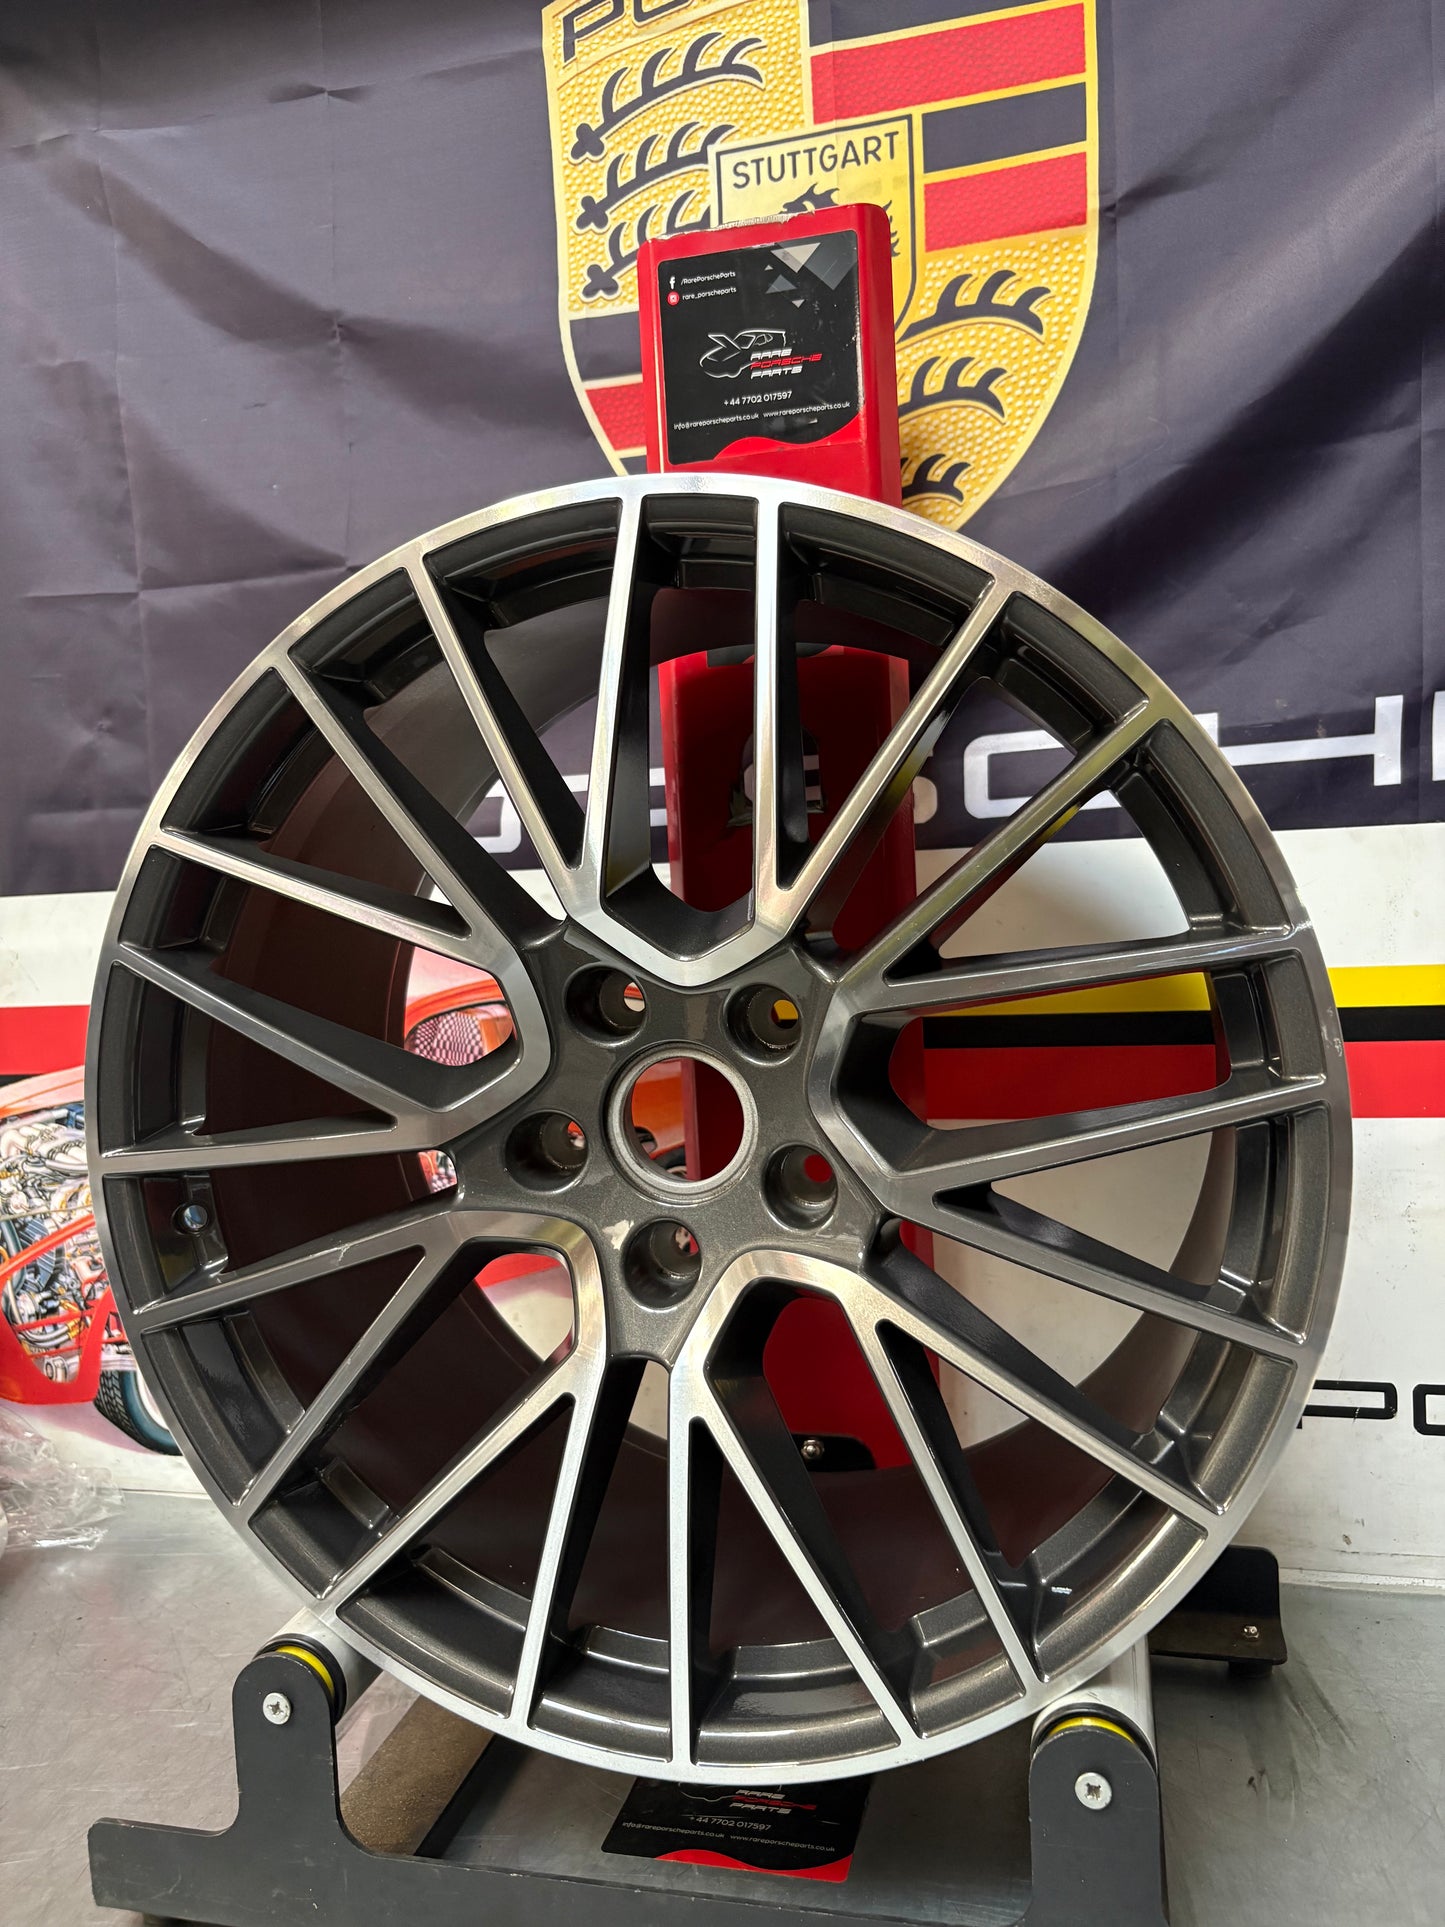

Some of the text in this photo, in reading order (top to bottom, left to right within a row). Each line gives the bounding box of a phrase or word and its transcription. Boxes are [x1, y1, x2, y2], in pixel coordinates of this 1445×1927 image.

[563, 0, 690, 63] P
[732, 130, 900, 189] STUTTGART
[750, 348, 793, 361] RARE
[750, 353, 823, 370] PORSCHE
[750, 365, 803, 380] PARTS
[741, 394, 762, 404] 7702
[763, 390, 793, 402] 017597
[763, 401, 851, 418] www.rareporscheparts.co.uk
